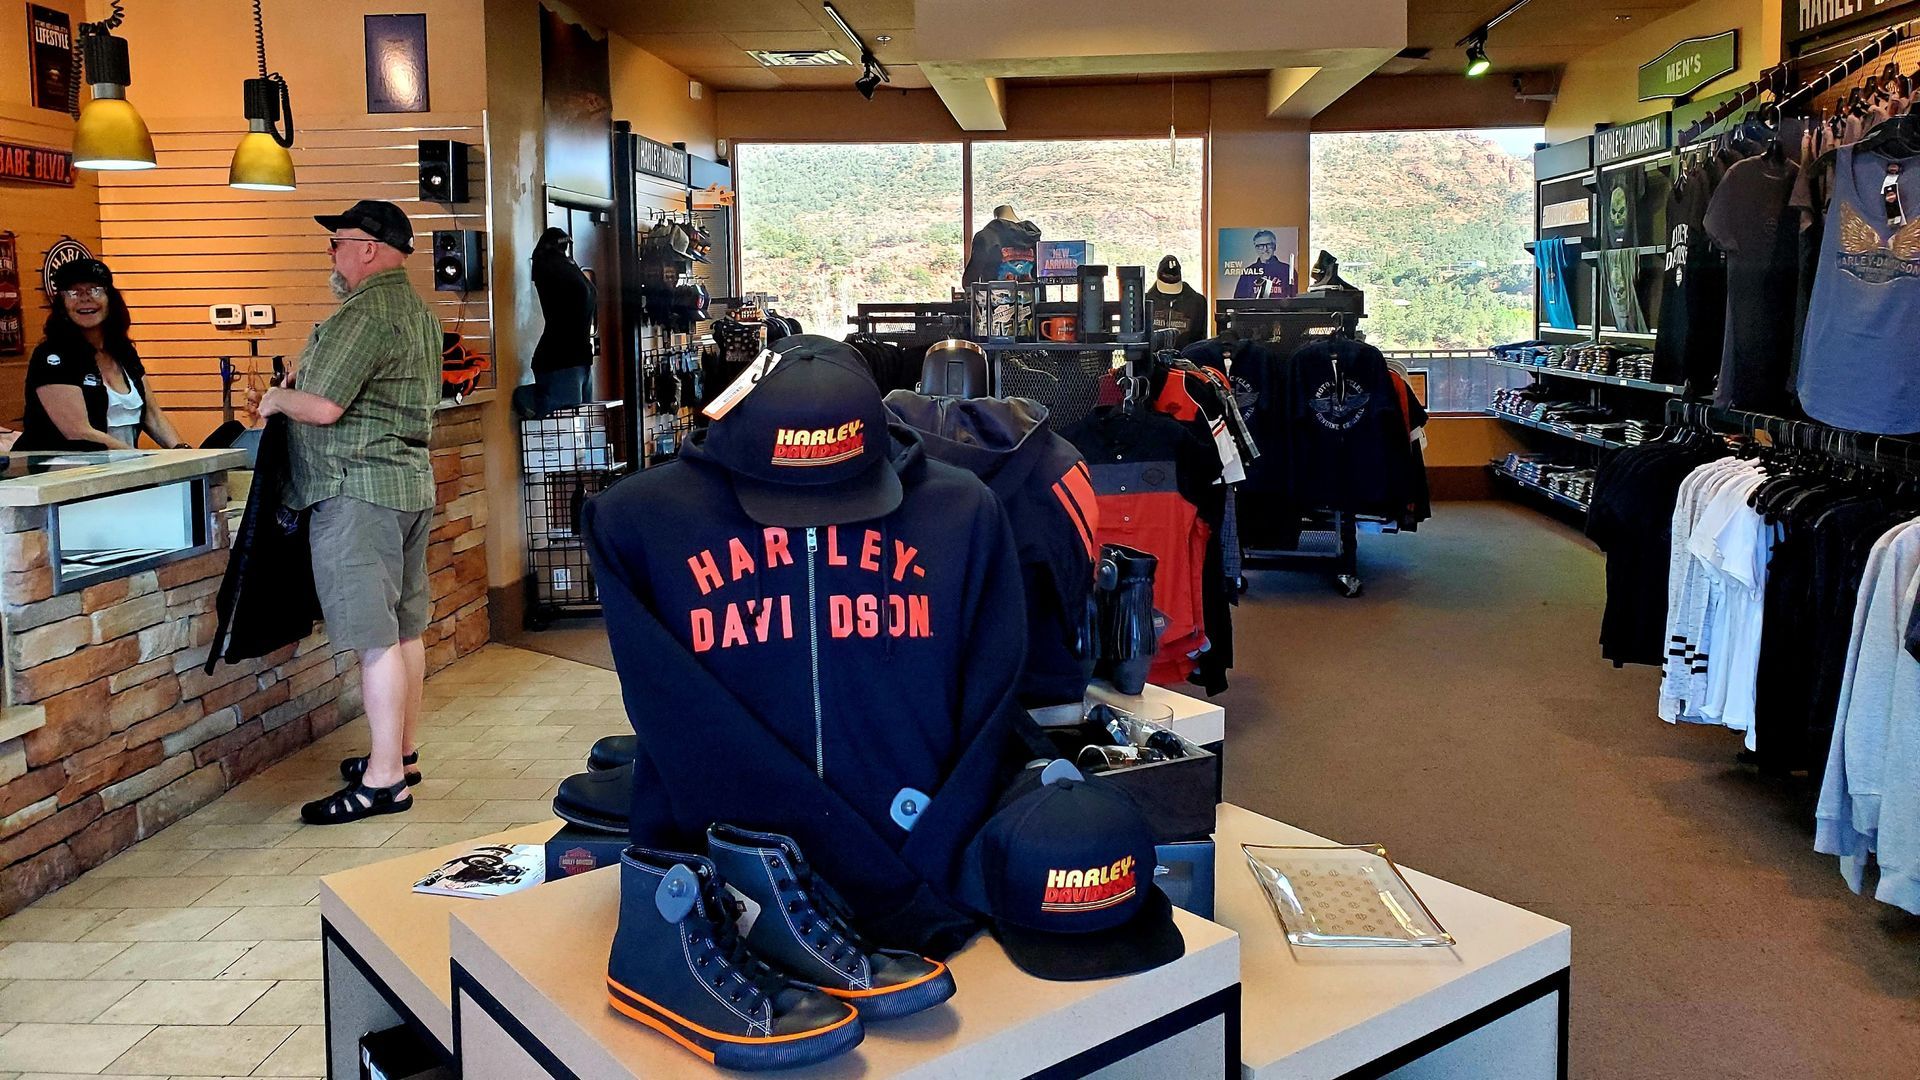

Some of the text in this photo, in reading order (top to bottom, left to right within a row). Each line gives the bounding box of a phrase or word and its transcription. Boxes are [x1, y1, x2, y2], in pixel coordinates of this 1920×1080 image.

[35, 26, 70, 50] LIFESTYLE
[1666, 54, 1702, 84] MEN'S
[1599, 117, 1660, 162] HARLEY-DAVIDSON
[1045, 259, 1078, 270] ARRIVALS
[1052, 248, 1071, 259] NEW
[1224, 260, 1243, 269] NEW
[1224, 267, 1265, 276] ARRIVALS
[773, 432, 864, 459] DAVIDSON
[1044, 870, 1136, 904] DAVIDSON
